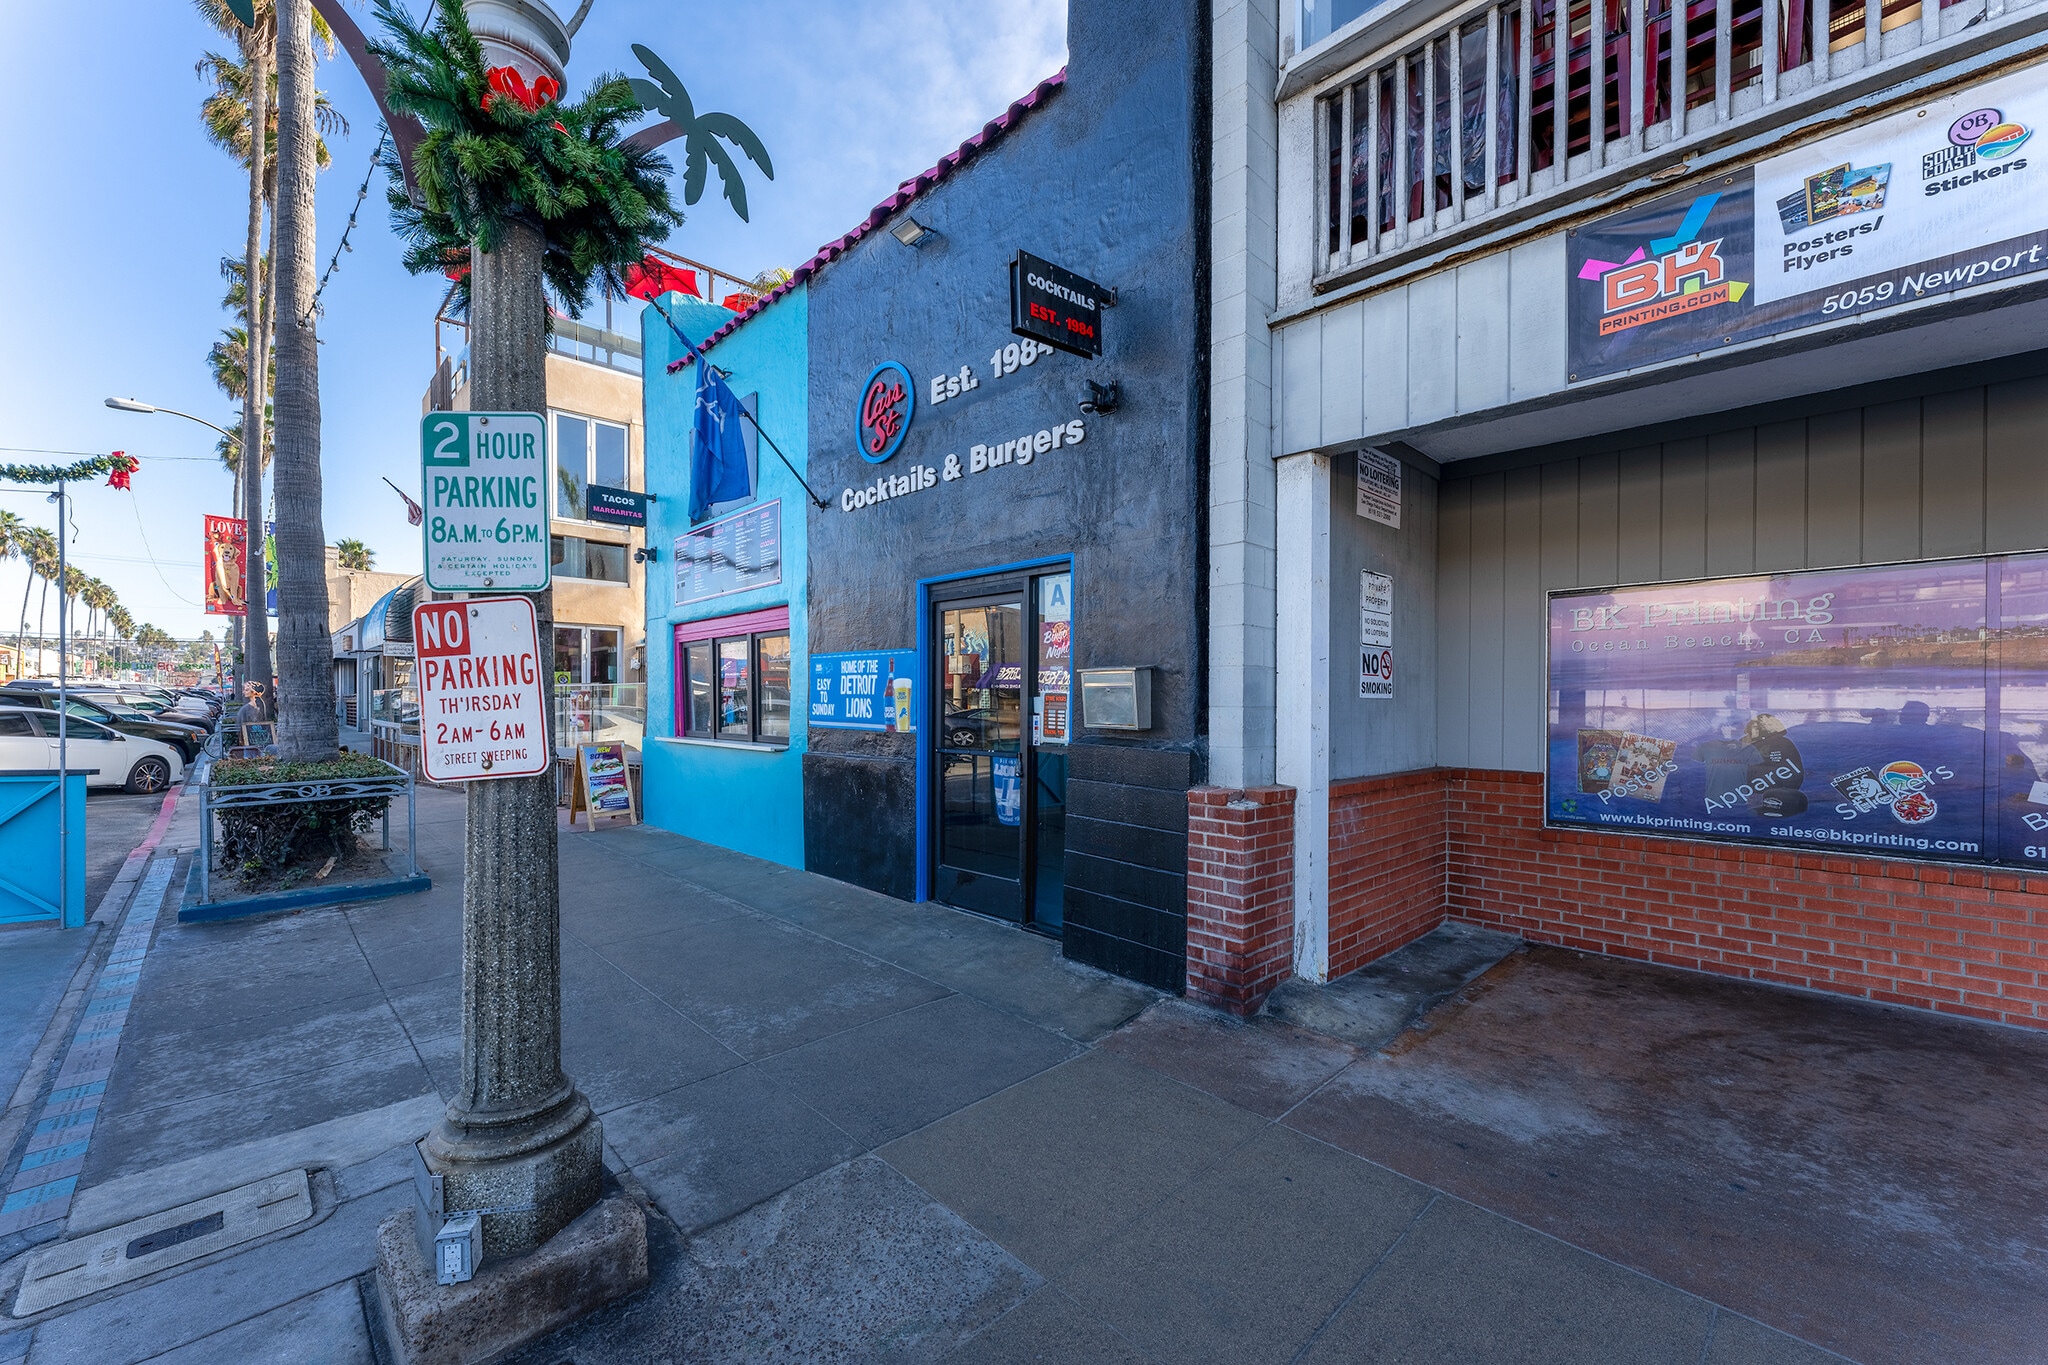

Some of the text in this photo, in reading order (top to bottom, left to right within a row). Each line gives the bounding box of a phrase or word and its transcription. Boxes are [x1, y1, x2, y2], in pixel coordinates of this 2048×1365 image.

[1961, 113, 1989, 131] OB
[1923, 152, 1974, 180] COAST
[1925, 158, 2028, 197] Stickers
[1784, 215, 1884, 257] Posters/
[1784, 245, 1853, 273] Flyers
[1604, 238, 1723, 314] BK
[1821, 243, 2043, 315] 5059 Newport
[1027, 272, 1096, 311] COCKTAILS
[1030, 301, 1094, 339] EST. 1984
[1602, 289, 1726, 331] PRINTING.COM
[931, 365, 979, 405] Est.
[863, 381, 906, 428] Cass
[433, 422, 535, 459] 2 HOUR
[871, 410, 902, 453] St.
[841, 419, 1085, 513] Cocktails & Burgers
[1360, 463, 1369, 477] NO
[1370, 467, 1399, 490] LOITERING
[434, 476, 537, 509] PARKING
[601, 494, 635, 506] TACOS
[593, 505, 643, 519] MARGARITAS
[210, 520, 242, 536] LOVE
[481, 529, 493, 538] TO
[1050, 584, 1065, 606] A
[1569, 592, 1836, 632] BK Printing
[420, 610, 463, 649] NO
[1043, 630, 1067, 644] Bingo
[1571, 628, 1827, 653] Ocean Beach, CA
[425, 653, 534, 691] PARKING
[840, 659, 878, 674] HOME OF THE
[1362, 653, 1379, 674] NO
[816, 678, 831, 691] EASY
[820, 691, 828, 703] TO
[840, 674, 878, 695] DETROIT
[1361, 681, 1392, 694] SMOKING
[812, 703, 835, 716] SUNDAY
[846, 697, 873, 719] LIONS
[444, 748, 528, 766] STREET SWEEPING
[297, 785, 332, 798] OB
[1597, 759, 1678, 805] Posters
[1704, 758, 1801, 814] Apparel
[1835, 765, 1955, 821] Stickers
[1600, 813, 1979, 853] www.bkprinting.com sales@bkprinting.com
